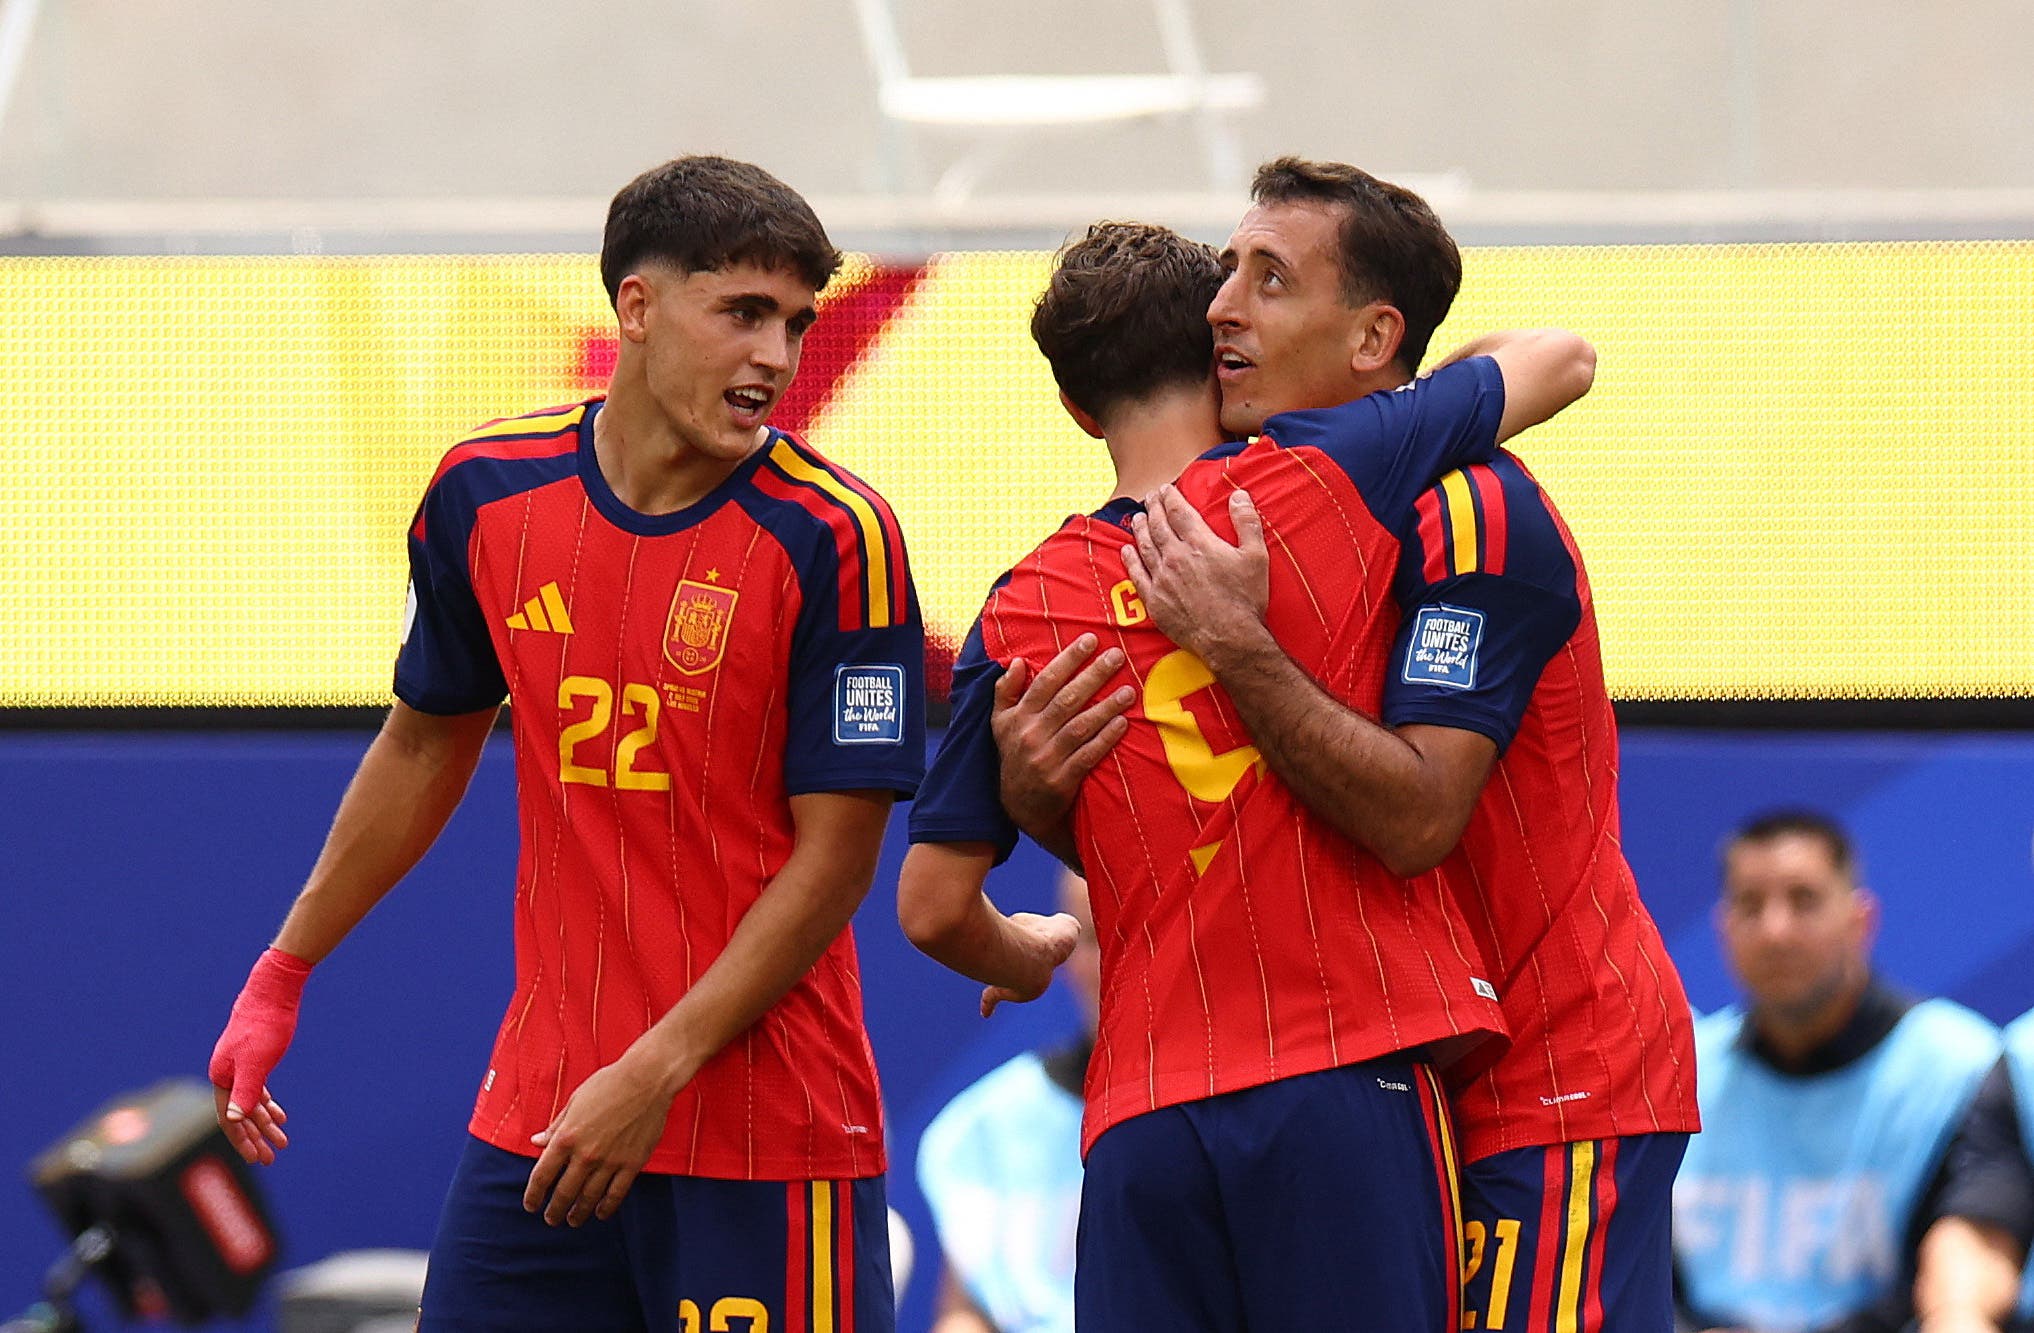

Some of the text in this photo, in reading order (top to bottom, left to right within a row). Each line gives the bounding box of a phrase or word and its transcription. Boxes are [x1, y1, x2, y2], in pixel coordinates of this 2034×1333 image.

[1424, 618, 1471, 636] FOOTBALL
[1421, 630, 1469, 653] UNITES
[1415, 648, 1469, 670] the World
[1428, 664, 1450, 674] FIFA
[846, 676, 893, 690] FOOTBALL
[846, 689, 893, 707] UNITES
[843, 706, 896, 723] the World
[558, 676, 670, 791] 22
[858, 722, 879, 732] FIFA
